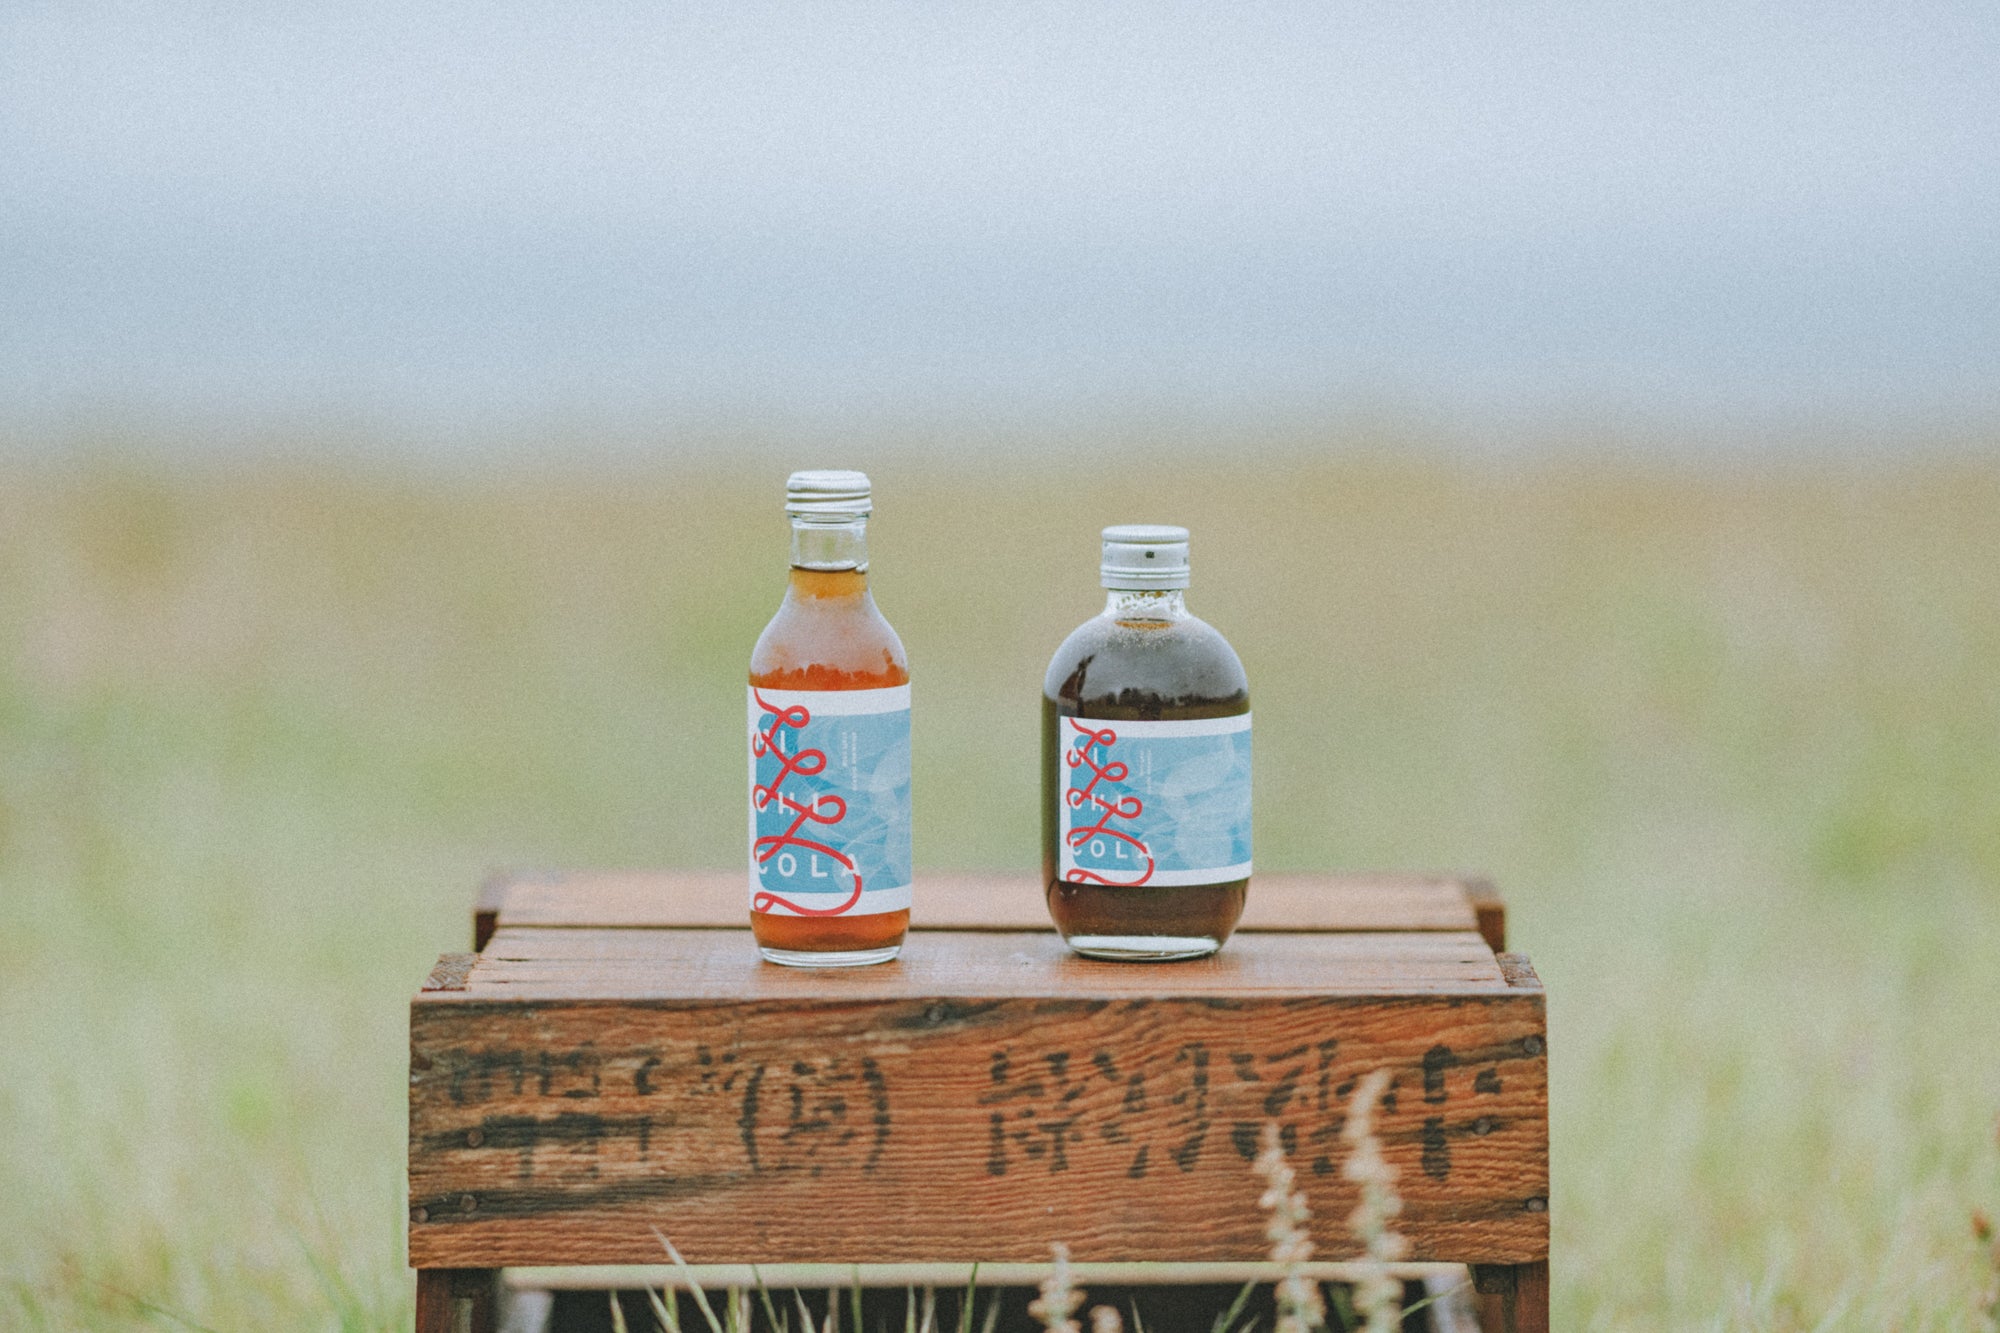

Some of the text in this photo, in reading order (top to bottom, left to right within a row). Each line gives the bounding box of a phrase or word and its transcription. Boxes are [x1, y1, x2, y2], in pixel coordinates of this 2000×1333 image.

[756, 788, 819, 815] CHI
[1070, 791, 1122, 812] CHI
[1071, 837, 1153, 859] COLA
[756, 850, 861, 878] COLA
